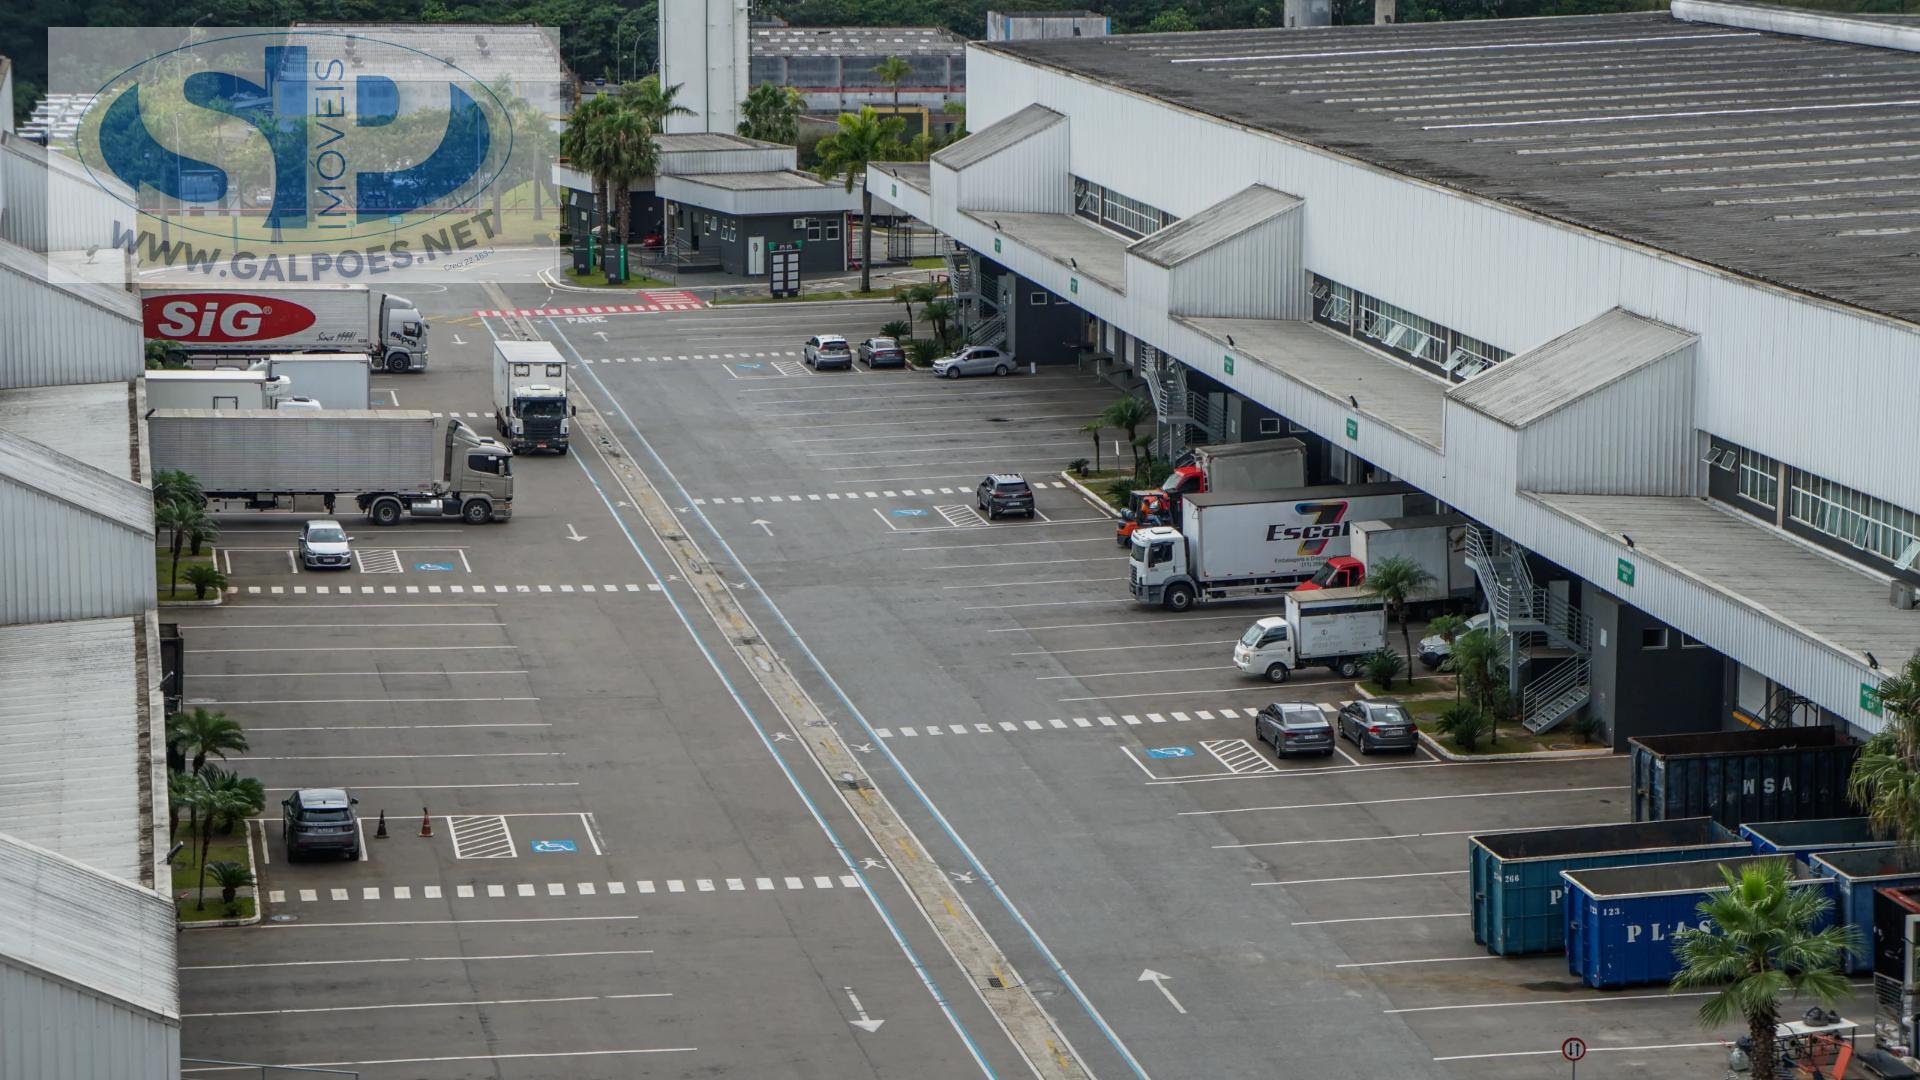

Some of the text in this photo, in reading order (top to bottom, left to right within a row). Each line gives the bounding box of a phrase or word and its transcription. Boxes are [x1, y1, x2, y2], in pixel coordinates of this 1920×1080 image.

[566, 316, 608, 324] PARE
[1743, 776, 1793, 795] WSA
[1504, 874, 1520, 883] 266
